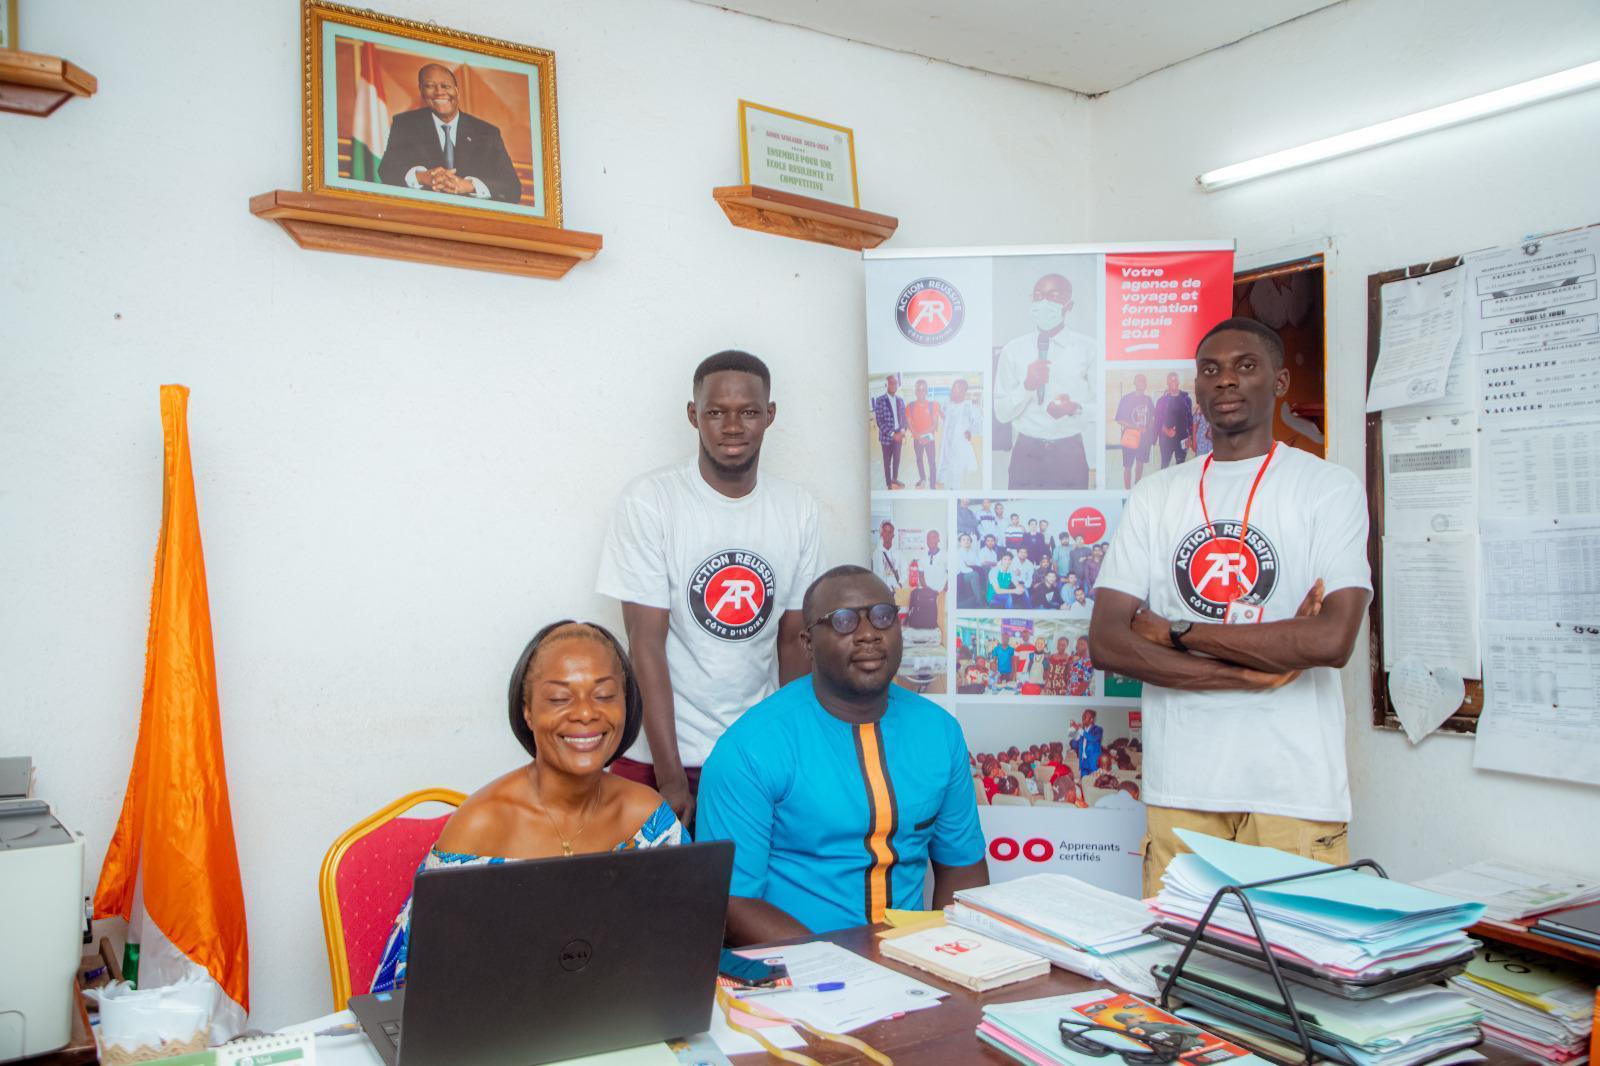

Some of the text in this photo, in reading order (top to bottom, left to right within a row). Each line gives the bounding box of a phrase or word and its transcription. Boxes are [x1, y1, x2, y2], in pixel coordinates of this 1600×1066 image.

[767, 146, 800, 162] ENSEMBLE
[800, 154, 818, 166] POUR
[766, 158, 787, 171] ECOLE
[826, 172, 834, 182] ET
[780, 174, 824, 191] COMPETITIVE
[1121, 267, 1164, 277] Votre
[1121, 278, 1201, 292] agence de
[898, 281, 924, 312] ACTION
[1121, 290, 1199, 304] voyage et
[1121, 302, 1198, 314] formation
[1121, 316, 1172, 328] depuis
[1121, 328, 1160, 339] 2018
[1484, 404, 1543, 414] VACANCES
[1176, 526, 1216, 570] ACTION
[691, 553, 774, 597] ACTION REUSSITE
[1190, 596, 1213, 614] CÔTE
[705, 616, 765, 637] CÔTE D'IVOIRE
[1060, 840, 1120, 852] Apprenants
[1060, 852, 1101, 862] certifiés
